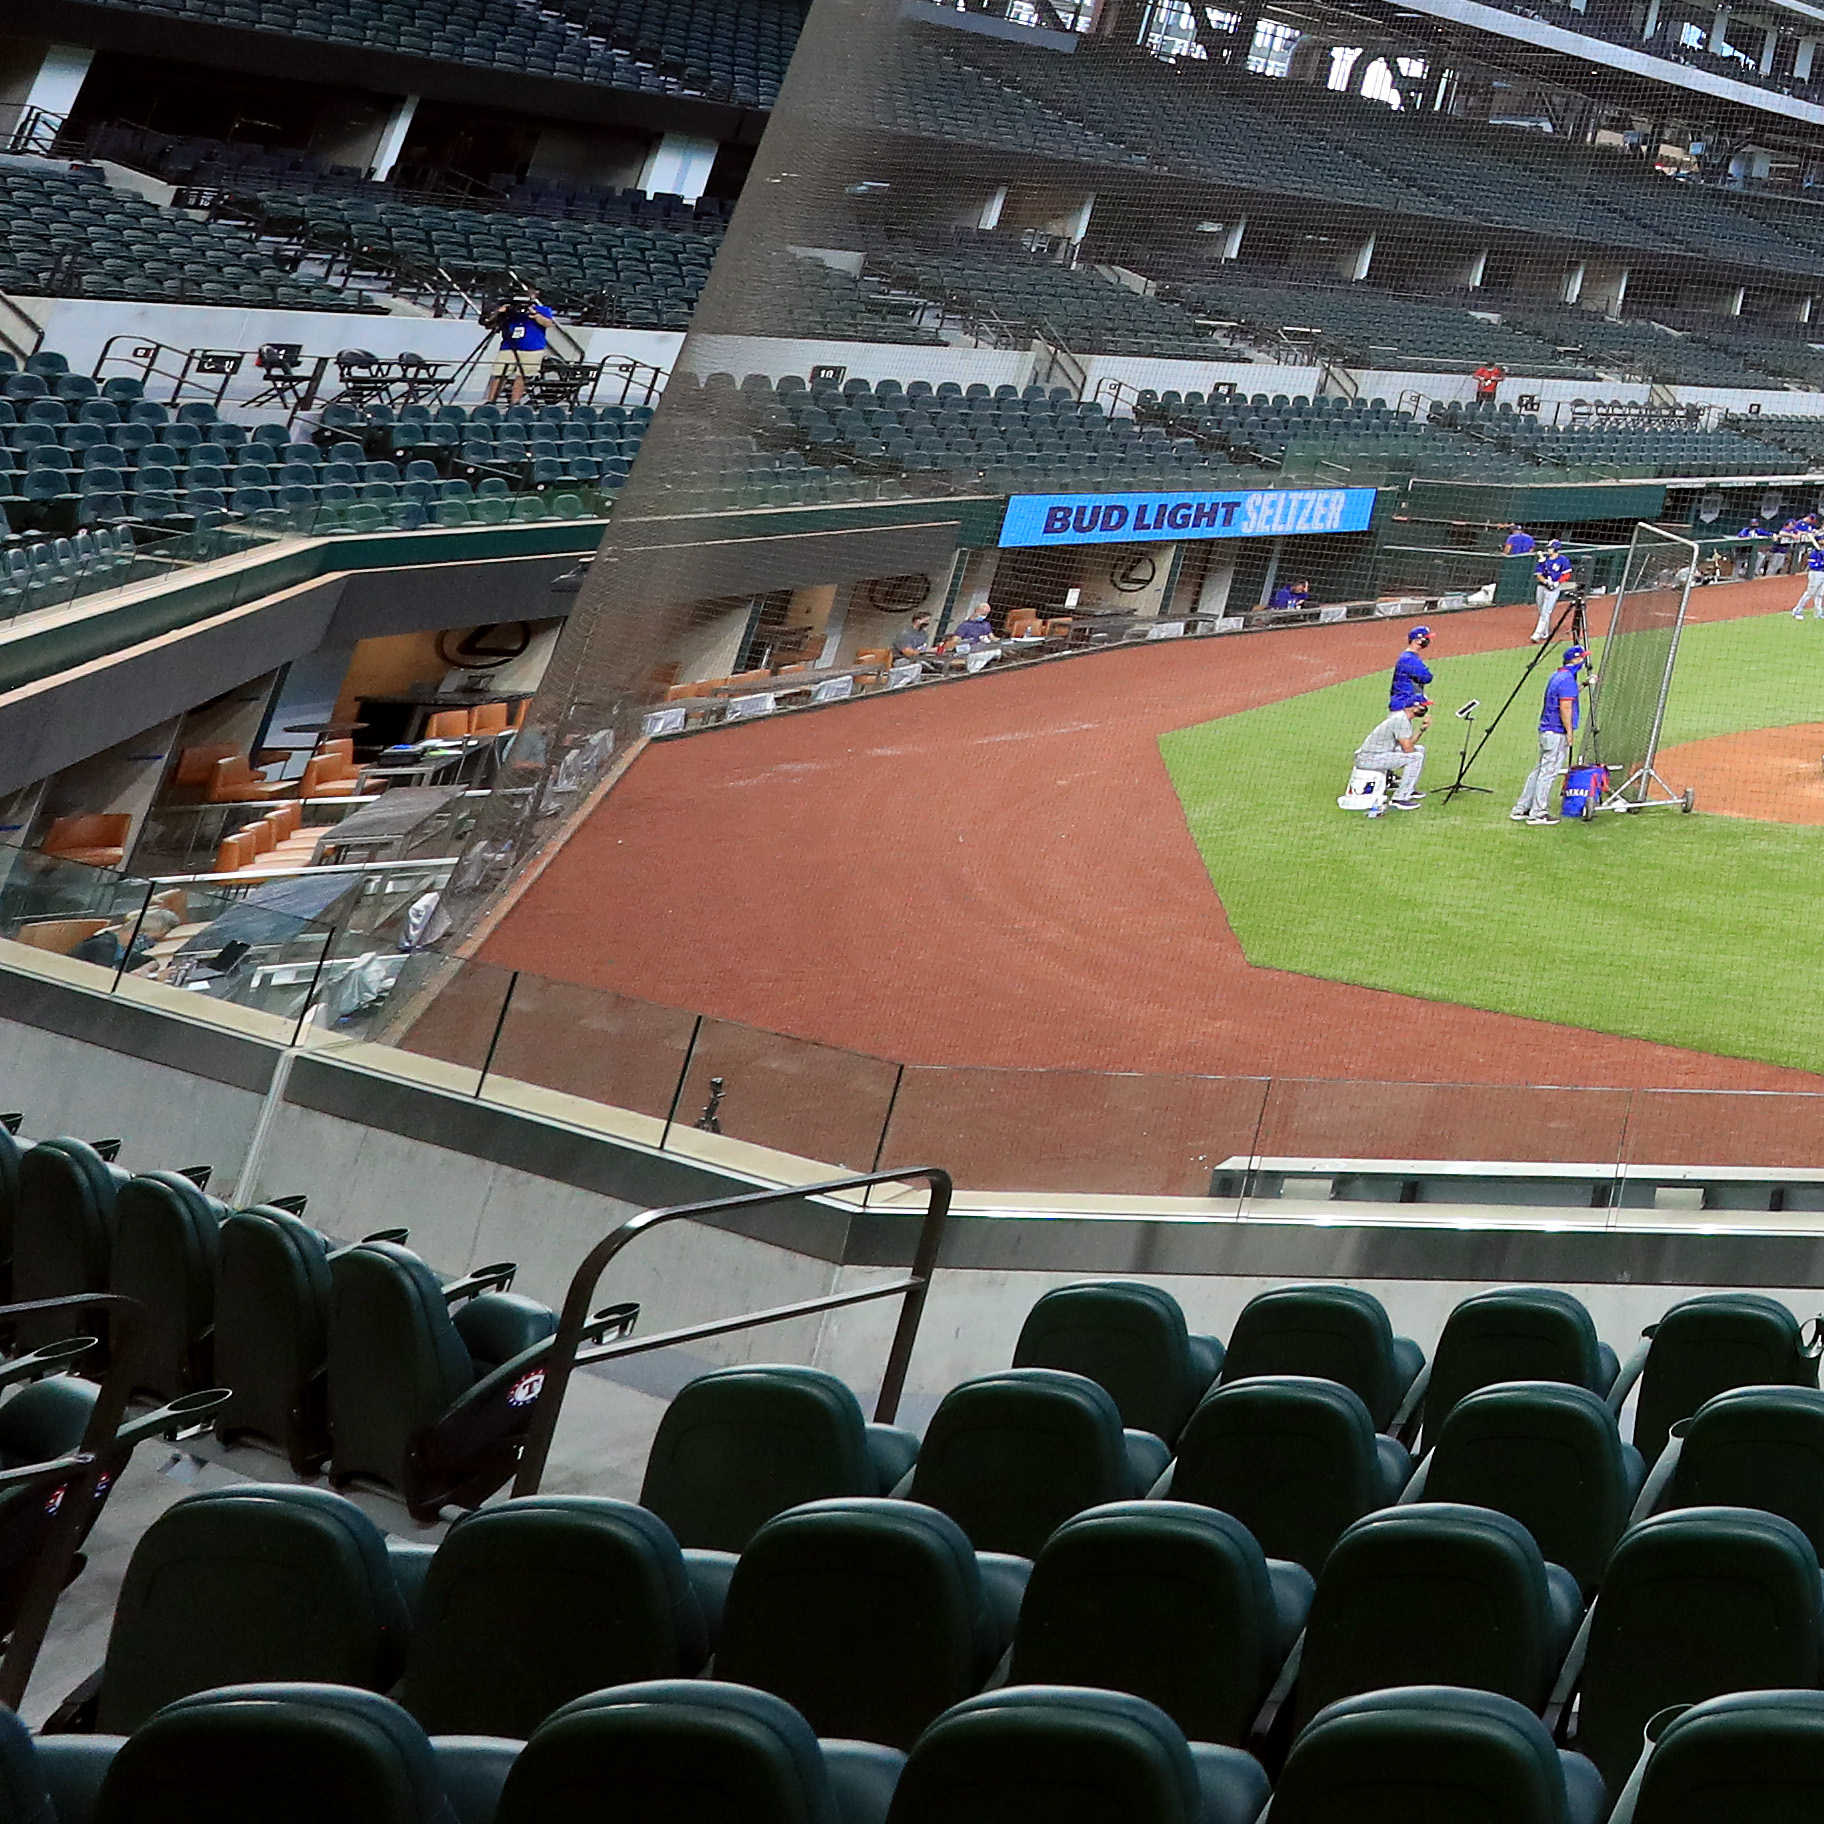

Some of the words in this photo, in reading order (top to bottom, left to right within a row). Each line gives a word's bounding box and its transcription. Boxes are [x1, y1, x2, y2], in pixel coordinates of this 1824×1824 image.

[1043, 504, 1130, 534] BUD
[1133, 501, 1242, 531] LIGHT
[1242, 491, 1346, 533] SELTZER
